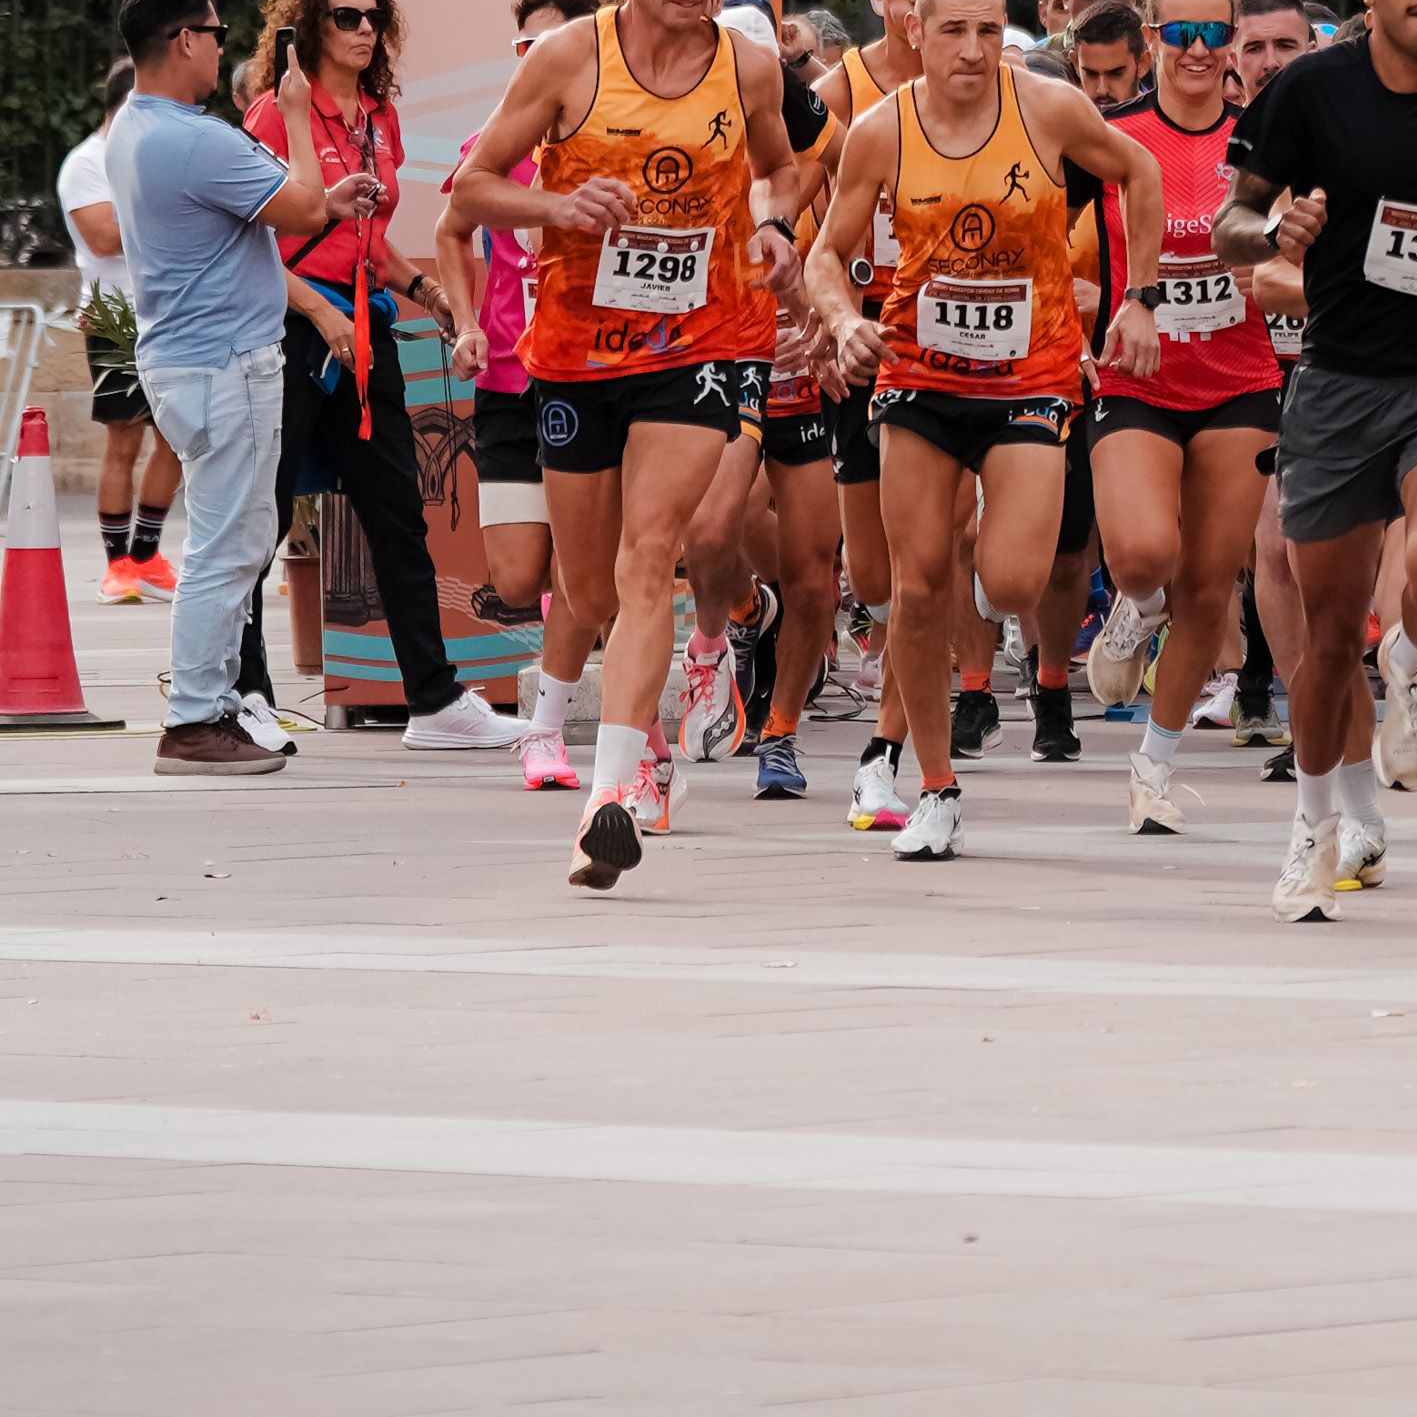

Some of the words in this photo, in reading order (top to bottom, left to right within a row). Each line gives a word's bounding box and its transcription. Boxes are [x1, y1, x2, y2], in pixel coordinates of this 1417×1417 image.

[638, 195, 714, 215] CONAY
[1167, 213, 1213, 238] igeS
[613, 250, 697, 283] 1298
[927, 248, 1025, 274] SECONAY
[640, 282, 671, 292] JAVIER
[935, 301, 1014, 332] 1118
